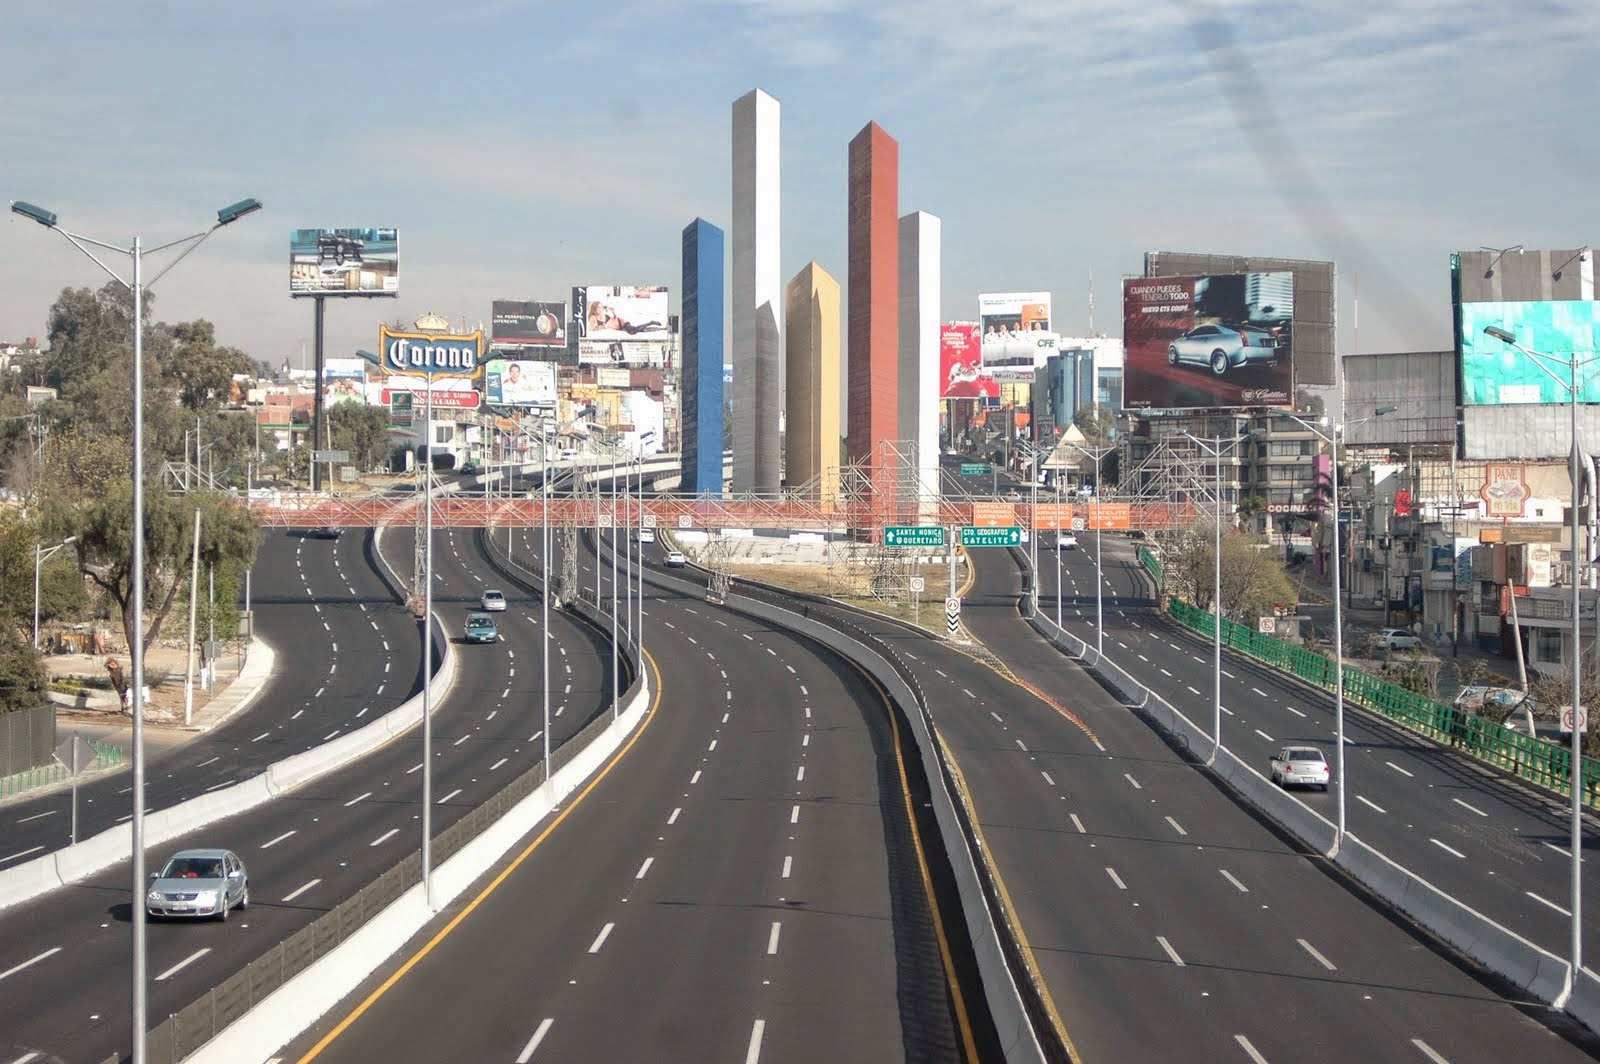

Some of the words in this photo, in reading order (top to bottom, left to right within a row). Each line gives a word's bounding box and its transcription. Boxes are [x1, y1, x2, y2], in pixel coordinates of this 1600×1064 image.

[1131, 286, 1156, 294] CUANDO
[1157, 285, 1182, 293] PUEDES
[1141, 293, 1169, 301] TENERLO
[1170, 292, 1190, 300] TODO.
[1037, 339, 1055, 347] CFE
[389, 338, 475, 370] Corona
[1495, 468, 1517, 482] PANE
[896, 528, 916, 536] SANTA
[919, 528, 942, 536] MONICA
[963, 528, 976, 536] CTO.
[977, 528, 1008, 536] GEOGRAFOS
